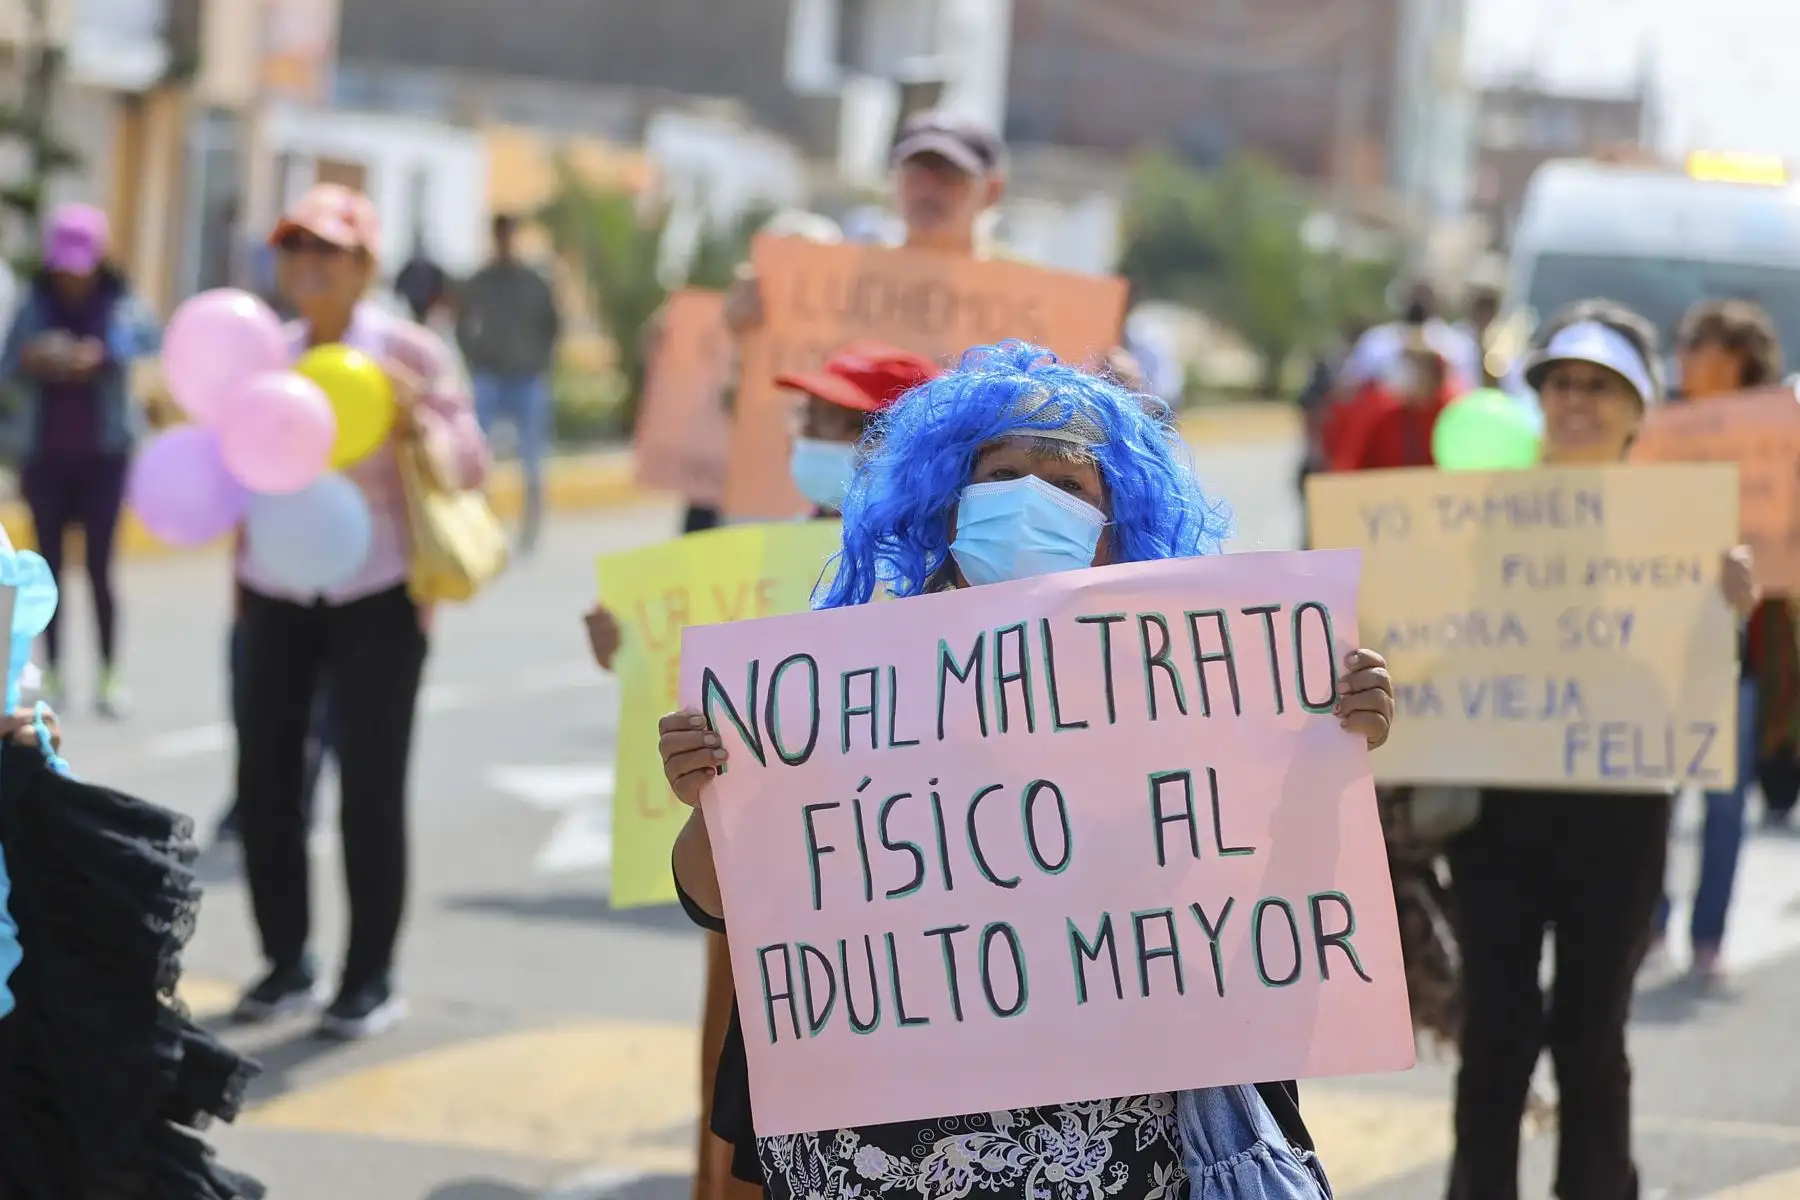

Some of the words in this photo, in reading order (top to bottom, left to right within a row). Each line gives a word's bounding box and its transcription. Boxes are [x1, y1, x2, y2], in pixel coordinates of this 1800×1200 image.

[1359, 502, 1412, 543] YO
[1556, 606, 1637, 651] SOY
[701, 652, 821, 776] NO
[840, 664, 921, 755] AL
[937, 600, 1342, 742] MALTRATO
[1562, 718, 1722, 780] FELIZ
[1147, 766, 1257, 868] AL
[756, 920, 1029, 1045] ADULTO
[1065, 890, 1373, 1006] MAYOR
